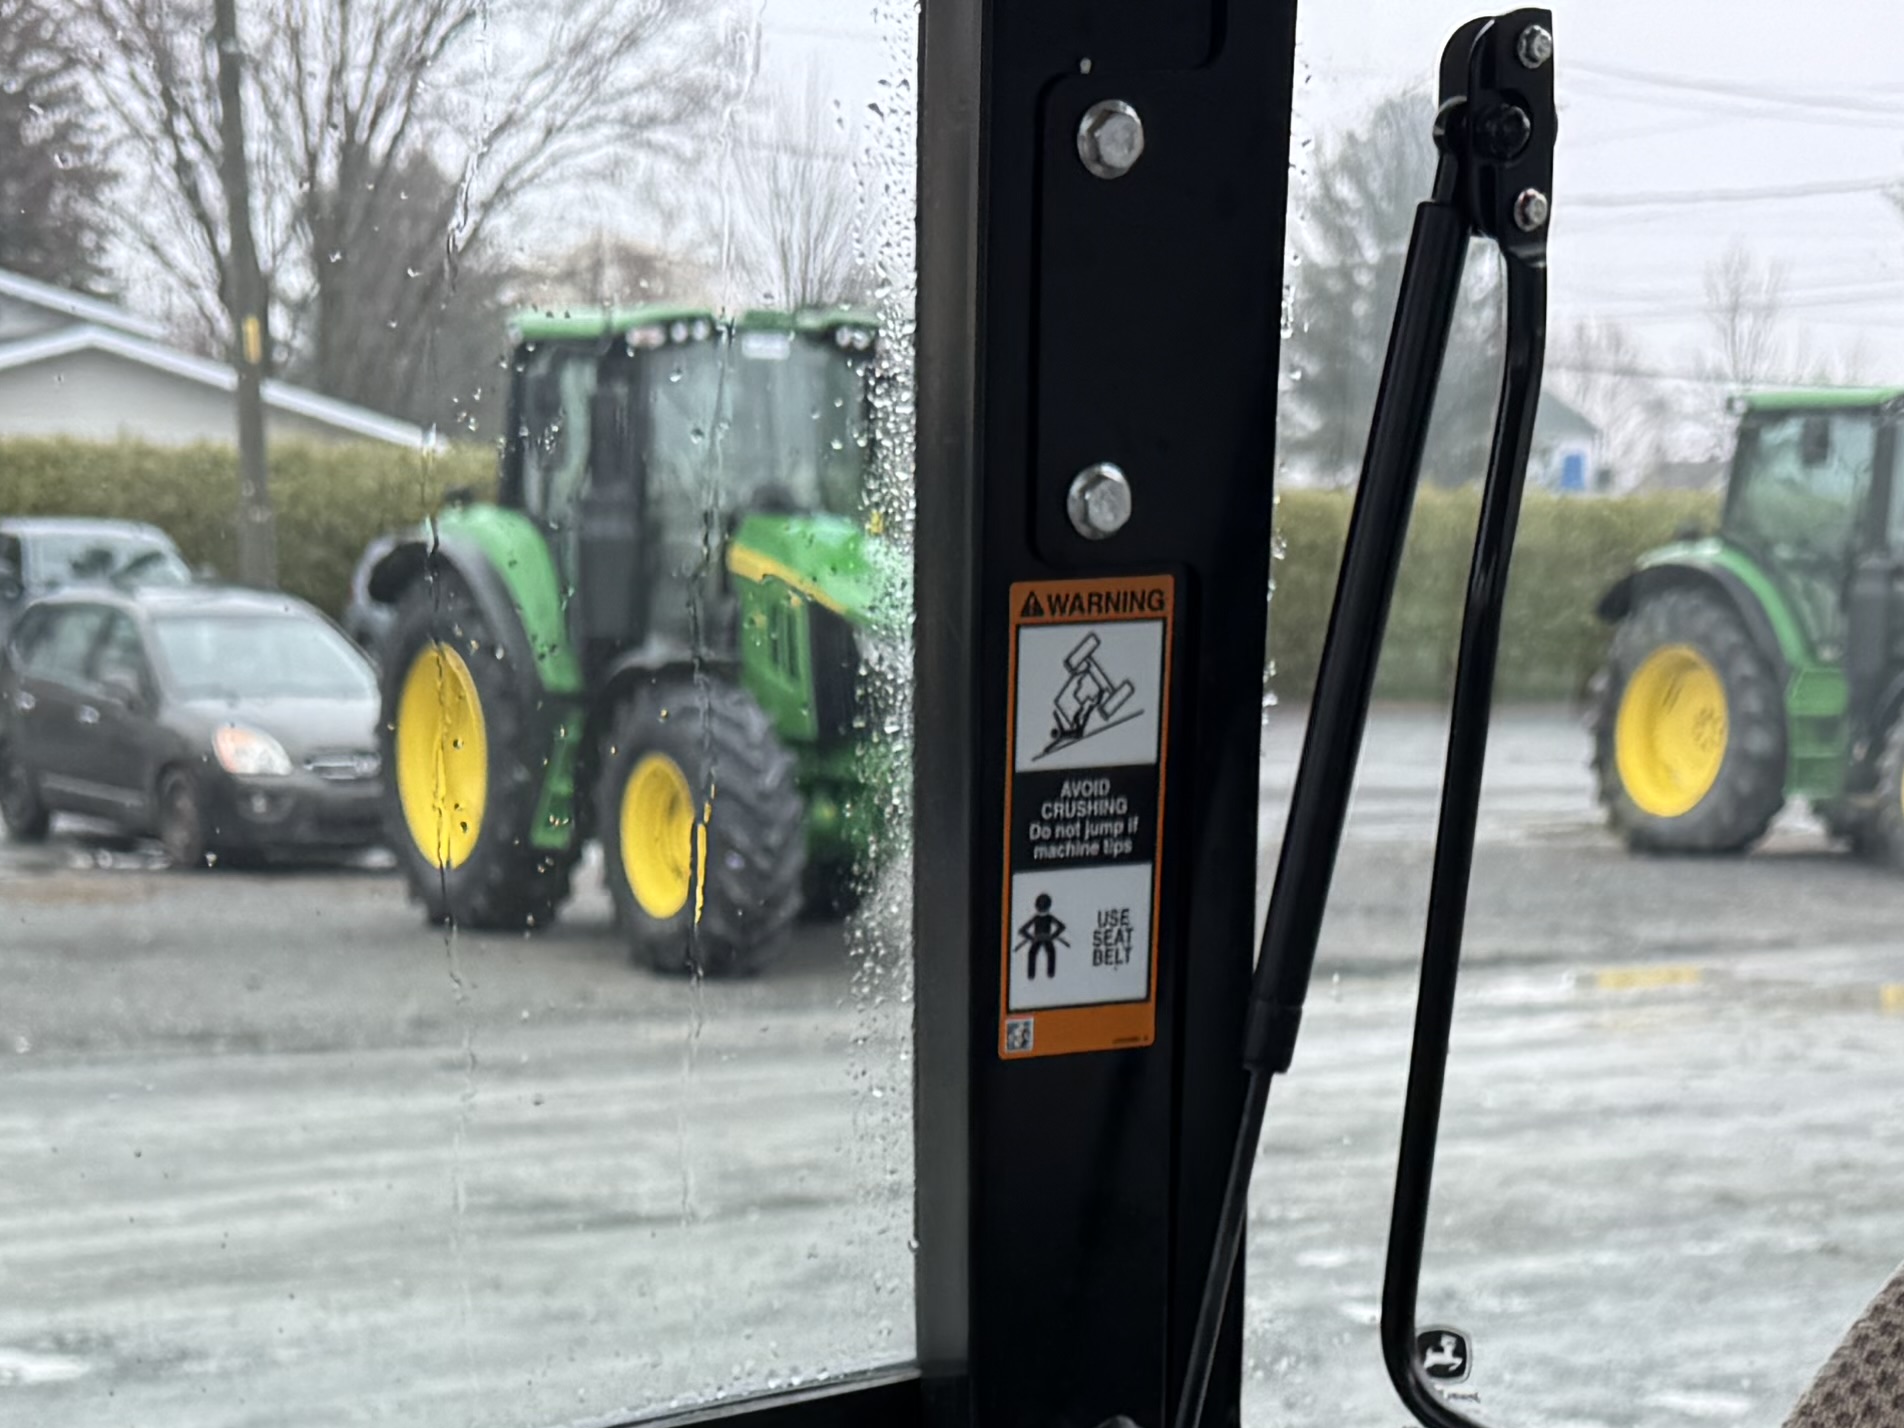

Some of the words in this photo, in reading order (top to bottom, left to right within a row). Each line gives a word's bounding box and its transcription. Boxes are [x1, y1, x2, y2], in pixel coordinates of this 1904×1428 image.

[1047, 588, 1165, 616] WARNING
[1060, 778, 1110, 798] AVOID
[1040, 797, 1128, 819] CRUSHING
[1029, 823, 1051, 841] Do
[1055, 820, 1081, 838] not
[1084, 819, 1124, 840] jump
[1128, 816, 1139, 834] if
[1033, 840, 1099, 860] machine
[1103, 839, 1133, 858] tips
[1097, 908, 1130, 928] USE
[1092, 927, 1134, 947] SEAT
[1092, 947, 1134, 967] BELT
